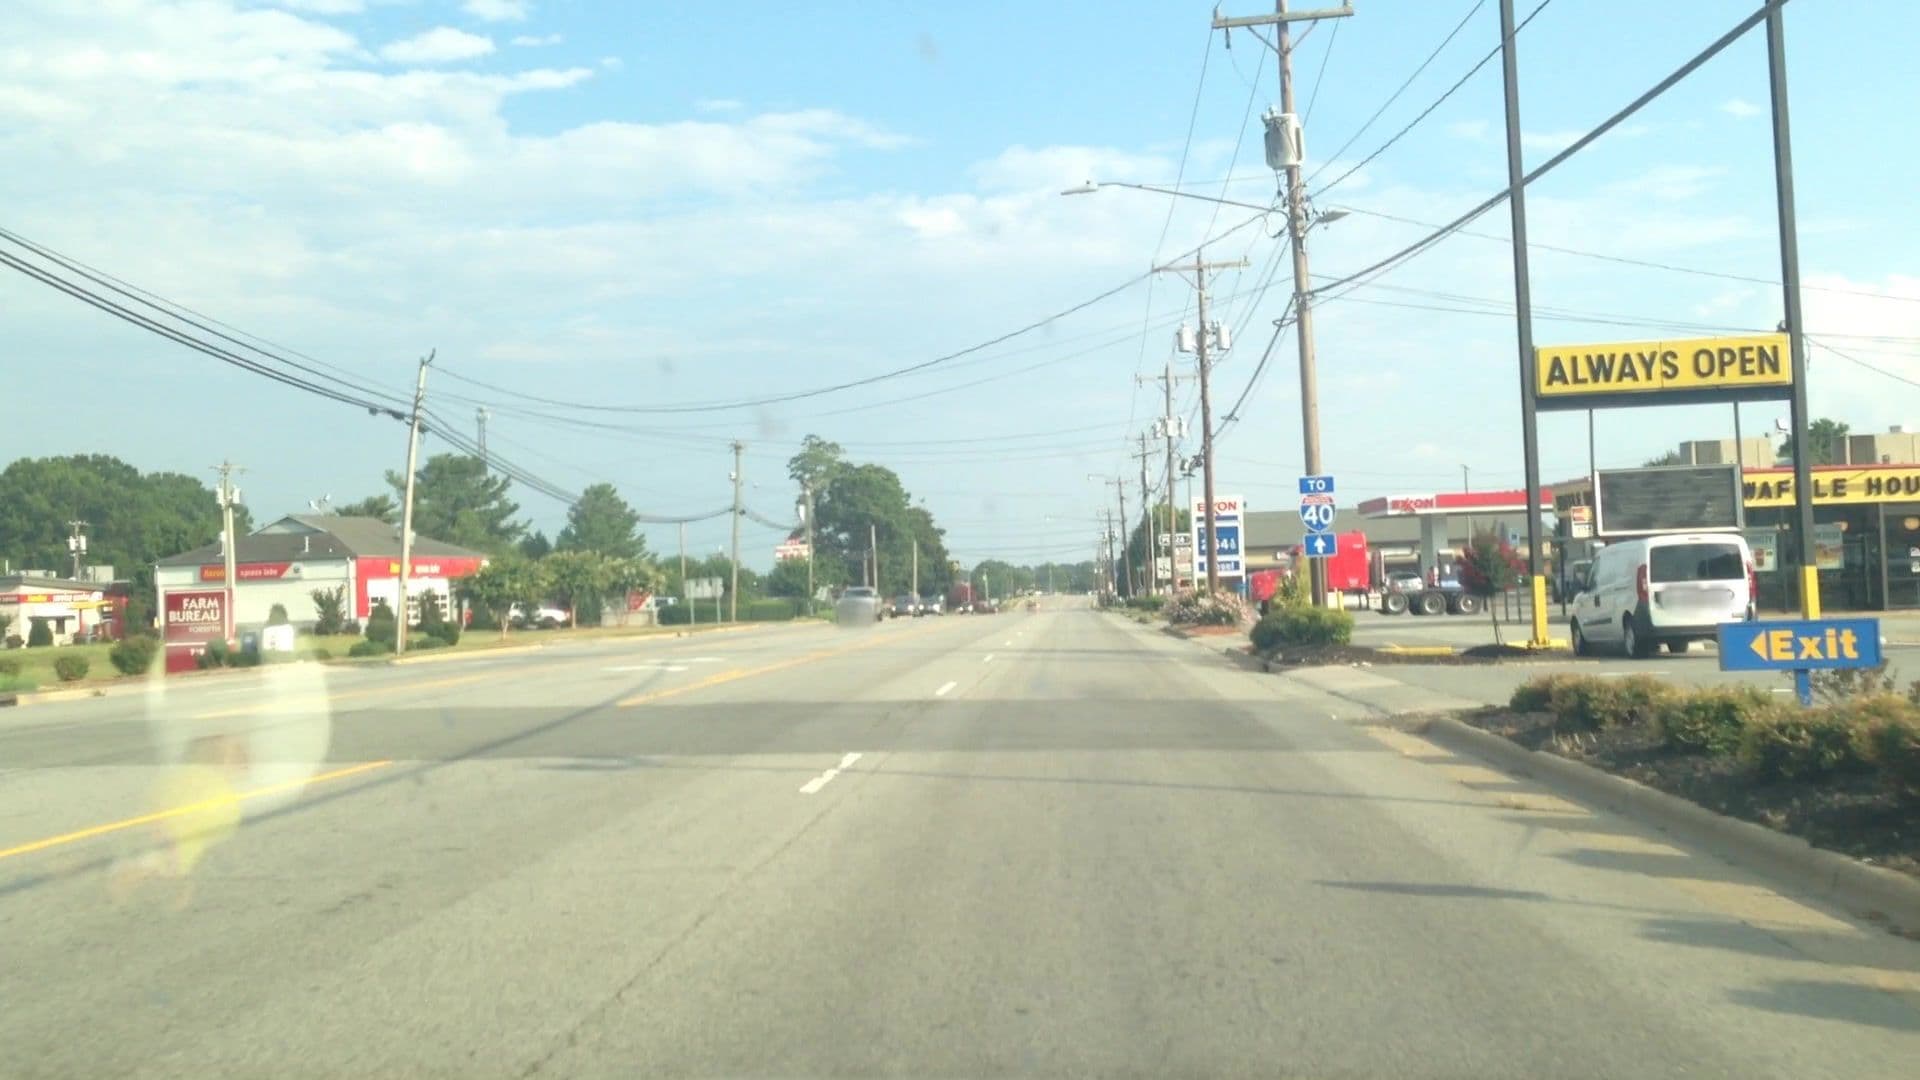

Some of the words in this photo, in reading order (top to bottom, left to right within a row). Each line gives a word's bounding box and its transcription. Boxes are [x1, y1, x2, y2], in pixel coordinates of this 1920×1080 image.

[1546, 350, 1679, 386] ALWAYS
[1694, 345, 1780, 379] OPEN
[1308, 479, 1326, 491] TO
[1744, 478, 1848, 501] WAFLE
[1197, 501, 1237, 513] EON
[1303, 504, 1333, 526] 40
[182, 598, 219, 609] FARM
[168, 609, 220, 622] BUREAU
[1769, 628, 1859, 661] Exit
